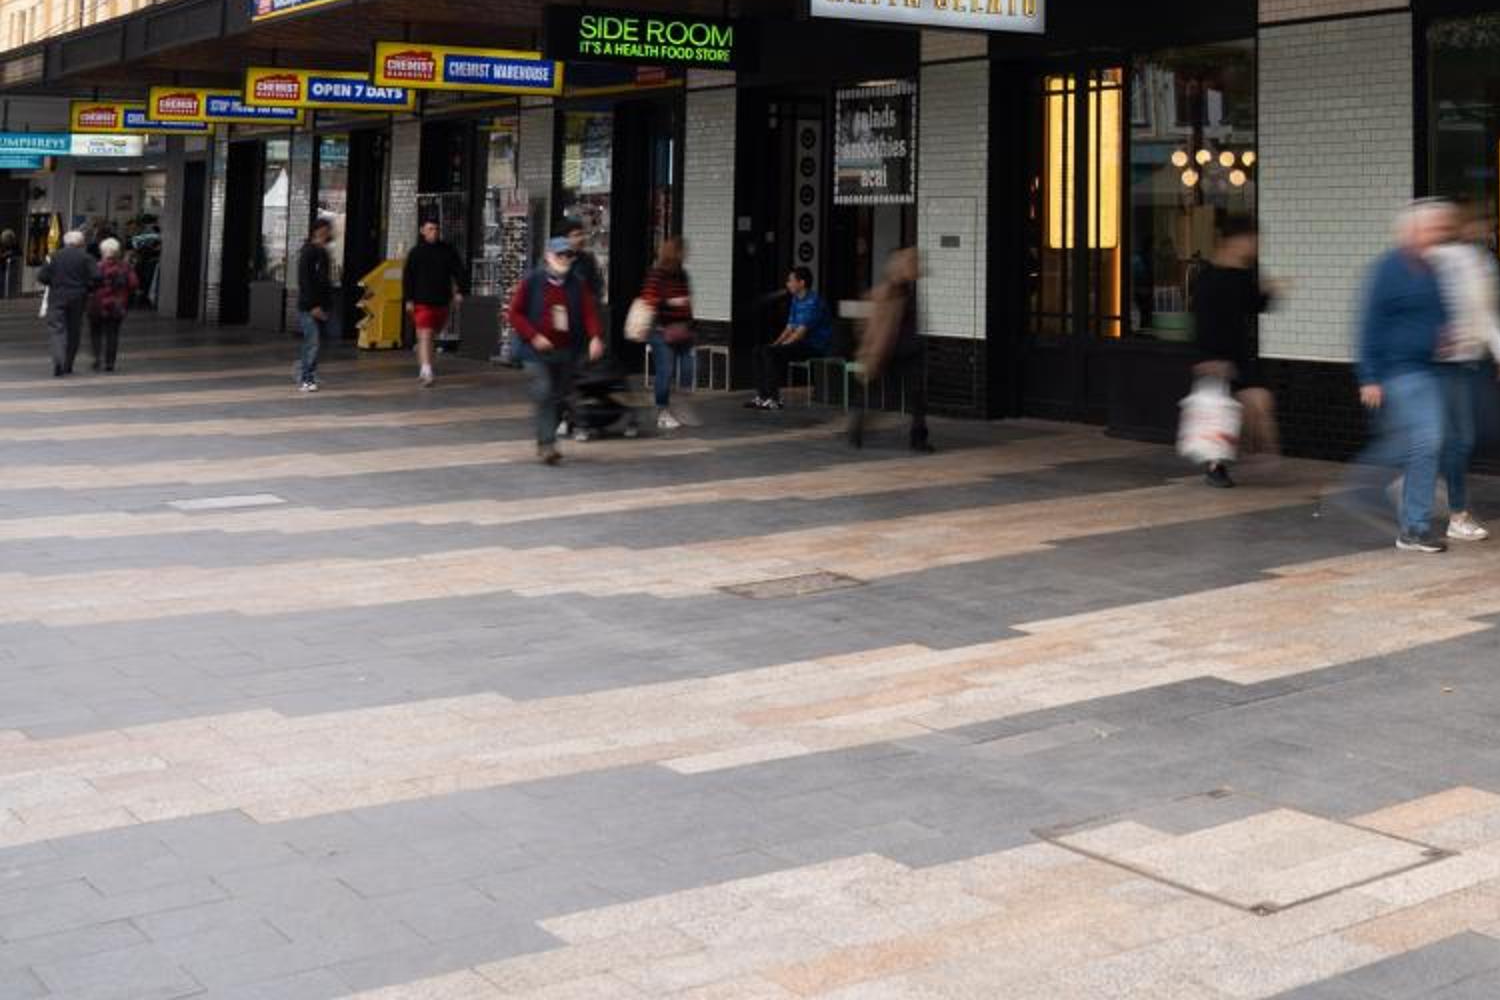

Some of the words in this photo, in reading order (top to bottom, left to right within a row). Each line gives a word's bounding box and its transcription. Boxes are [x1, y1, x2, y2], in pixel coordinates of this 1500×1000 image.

[579, 15, 639, 41] SIDE
[647, 21, 733, 47] ROOM
[579, 41, 601, 54] IT'S
[603, 42, 613, 55] A
[615, 43, 658, 57] HEALTH
[661, 45, 694, 60] FOOD
[696, 49, 730, 62] STORE
[386, 59, 434, 72] CHEMIST
[449, 61, 489, 79] CHEMIST
[493, 63, 550, 81] WAREHOUSE
[312, 82, 351, 97] OPEN
[355, 85, 364, 97] 7
[366, 86, 403, 99] DAYS
